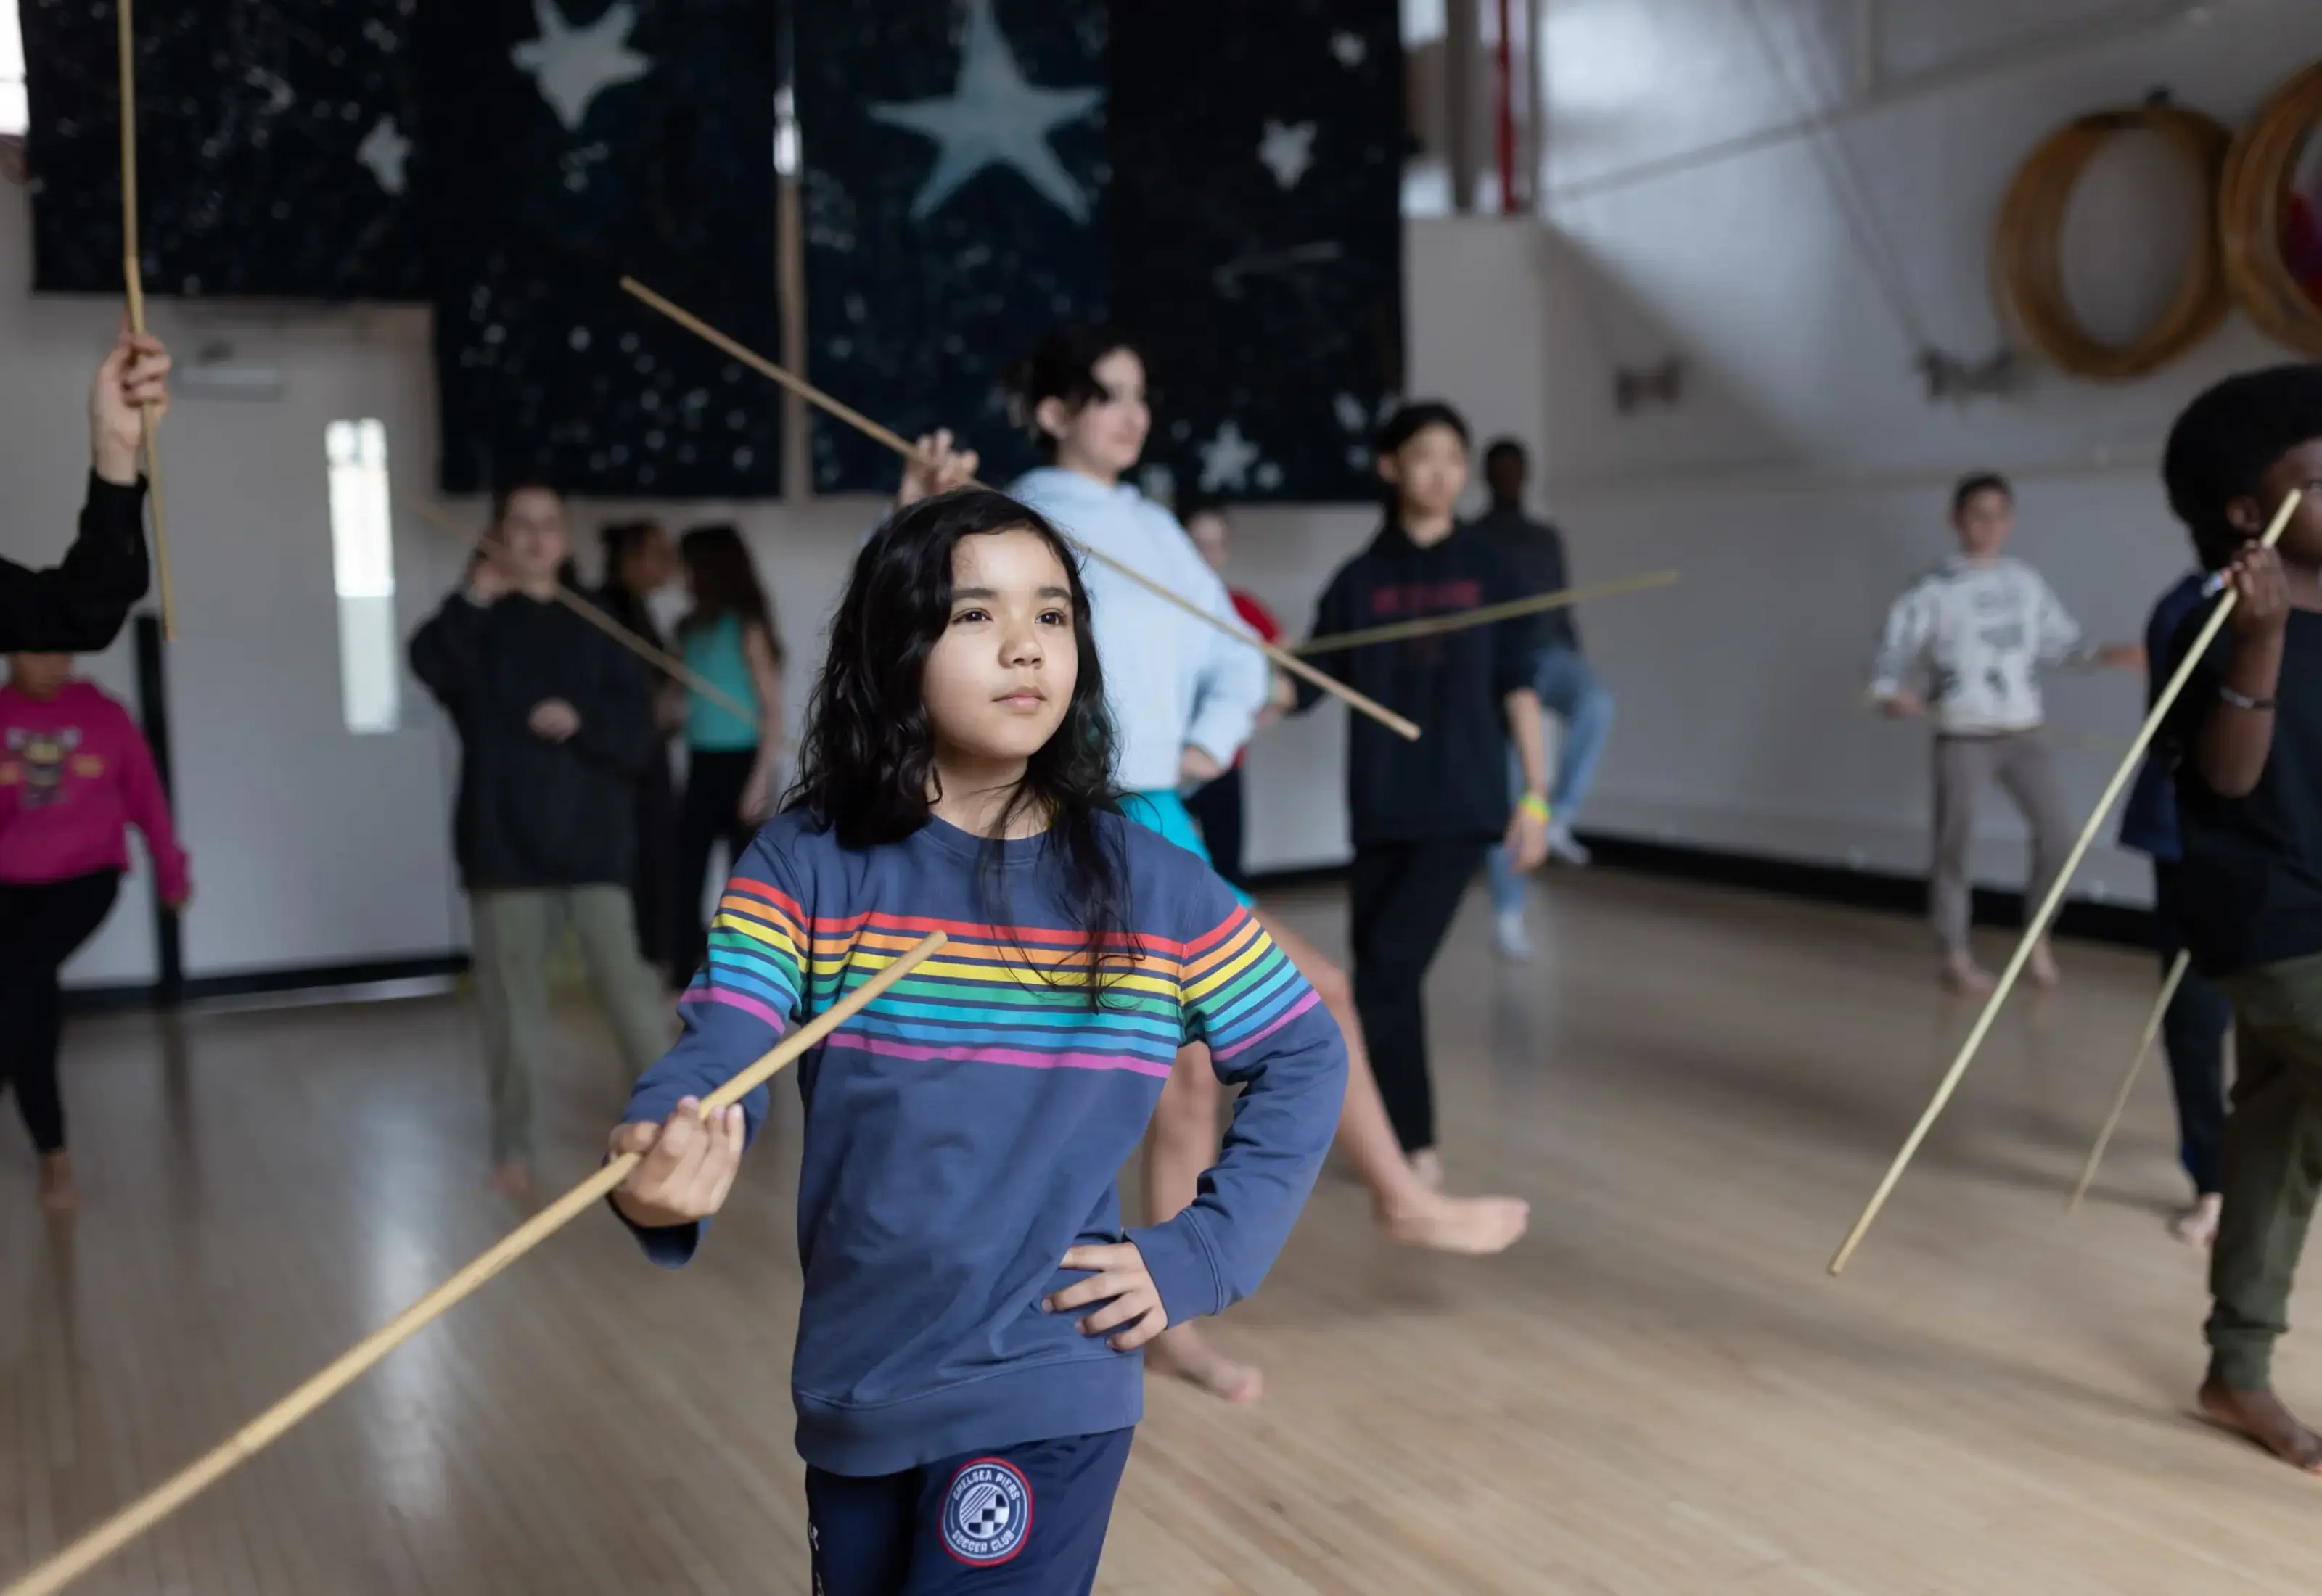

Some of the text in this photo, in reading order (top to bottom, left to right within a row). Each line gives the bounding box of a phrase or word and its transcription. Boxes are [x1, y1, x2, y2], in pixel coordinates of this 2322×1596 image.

[953, 1470, 1020, 1500] CHELSEA PIERS
[951, 1530, 1014, 1552] SOCCER CLUB
